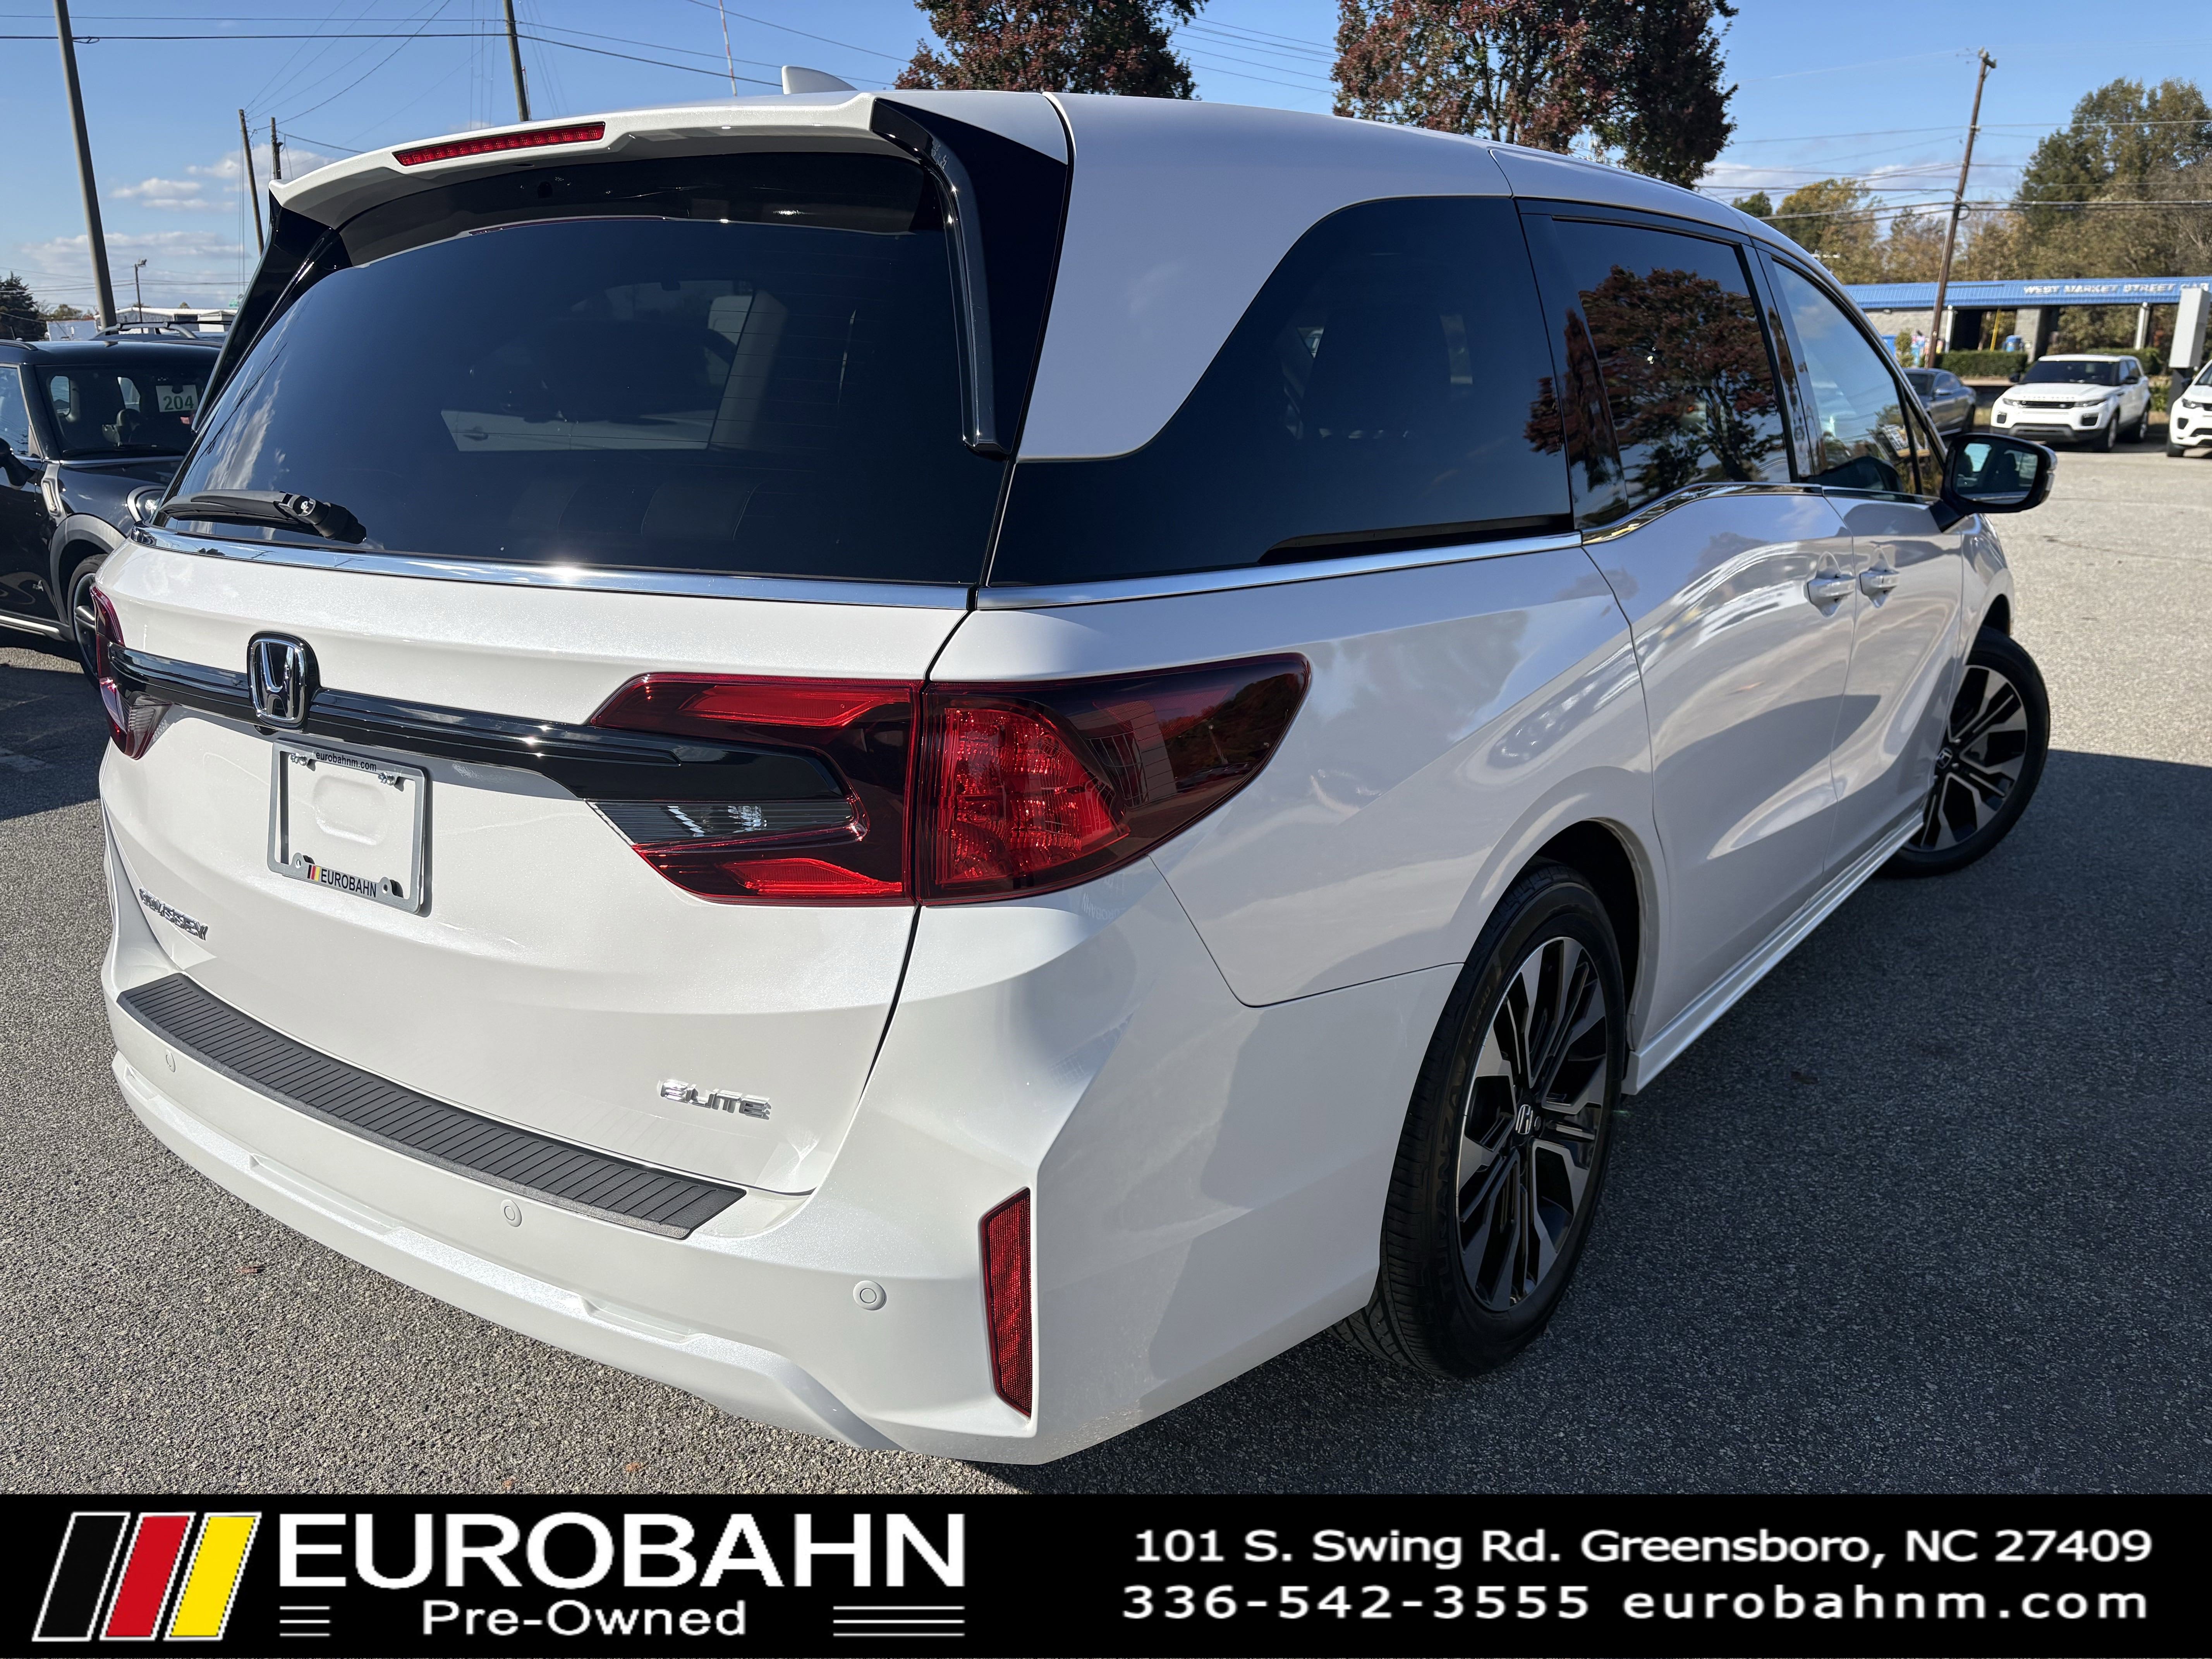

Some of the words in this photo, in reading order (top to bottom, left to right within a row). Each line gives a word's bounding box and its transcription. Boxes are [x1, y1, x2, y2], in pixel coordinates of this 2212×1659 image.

[2023, 285, 2060, 295] WEST
[2063, 284, 2119, 294] MARKET
[2123, 283, 2177, 293] STREET
[163, 395, 194, 410] 204
[316, 751, 377, 772] eurobahnm.com
[321, 868, 377, 898] EUROBAHN
[658, 1080, 771, 1120] ELITE
